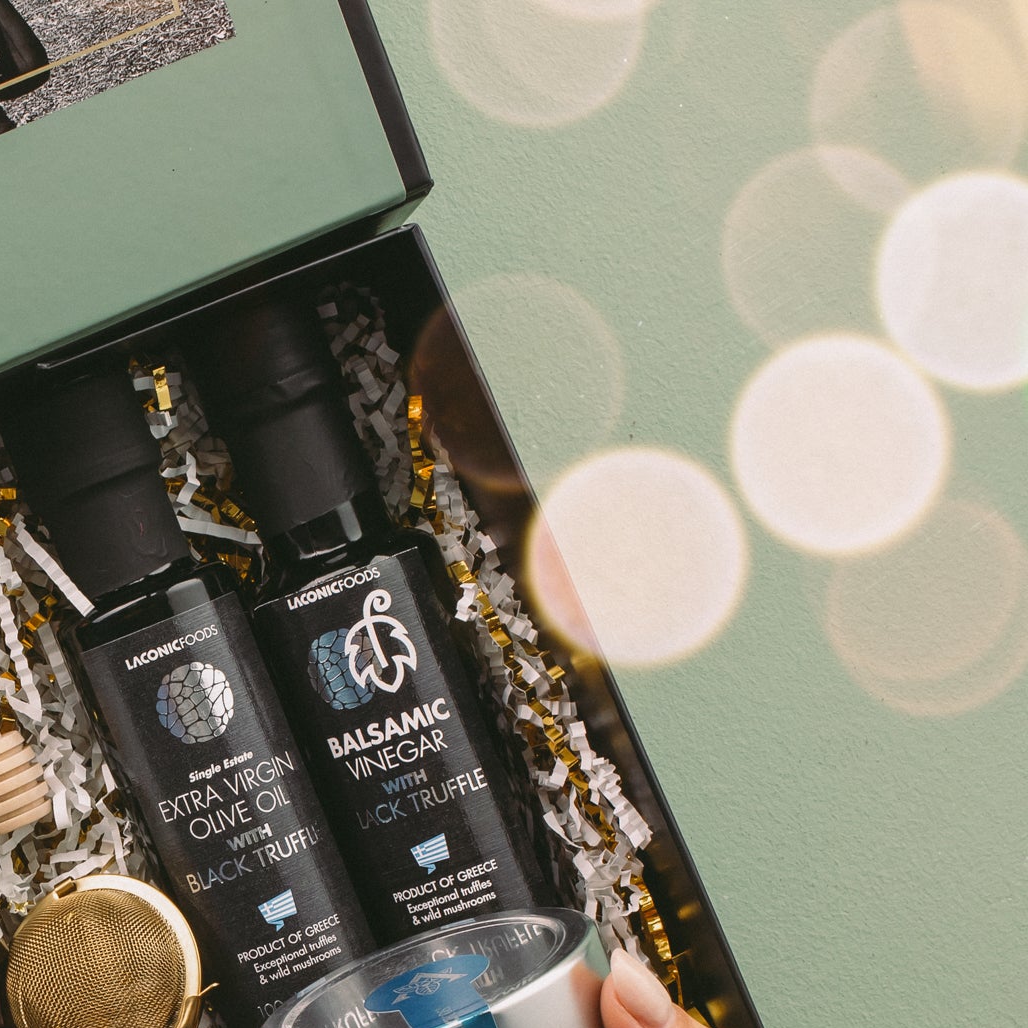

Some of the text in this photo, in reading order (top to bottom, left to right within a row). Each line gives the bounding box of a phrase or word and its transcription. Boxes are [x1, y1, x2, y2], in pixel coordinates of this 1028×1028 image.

[286, 567, 380, 610] LACONICFOODS
[125, 624, 218, 670] LACONICFOODS
[327, 697, 450, 759] BALSAMIC
[189, 751, 253, 783] Single Estate
[345, 729, 448, 780] VINEGAR
[158, 751, 294, 823] EXTRA VIRGIN
[381, 768, 428, 795] WITH
[407, 767, 488, 813] TRUFFLE
[189, 785, 290, 839] OLIVE OIL
[226, 823, 273, 851] WITH
[186, 854, 253, 894] BLACK
[393, 859, 498, 903] PRODUCT OF GREECE
[407, 879, 492, 914] Exceptional truffles
[412, 891, 497, 926] & wild mushrooms
[237, 913, 340, 964] PRODUCT OF GREECE
[253, 934, 337, 973] Exceptional truffles
[260, 946, 342, 985] & wild mushrooms
